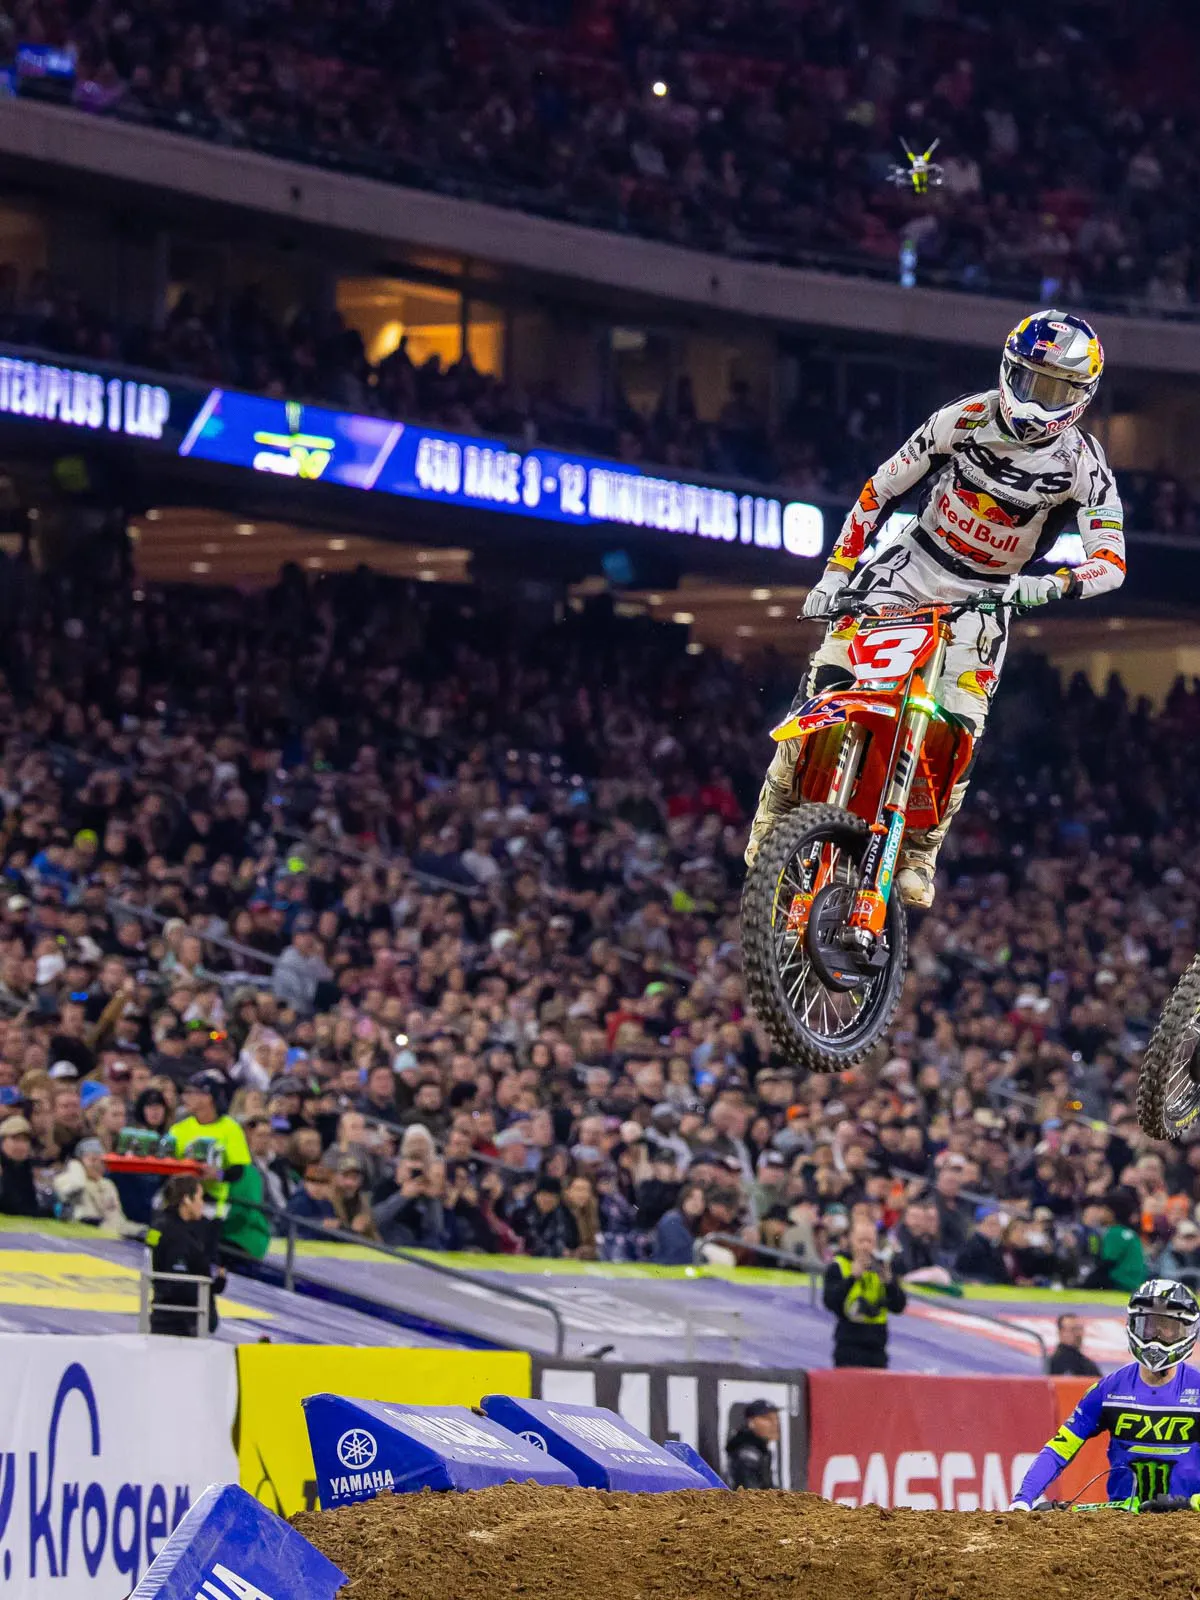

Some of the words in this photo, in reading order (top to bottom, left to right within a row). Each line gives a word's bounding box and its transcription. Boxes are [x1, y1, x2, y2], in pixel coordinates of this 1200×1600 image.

[107, 379, 122, 432] 1
[124, 381, 170, 440] LAP
[559, 463, 587, 514] 12
[754, 497, 782, 550] LA
[938, 493, 975, 535] Red
[973, 522, 1020, 553] Bull
[853, 627, 929, 681] 3
[884, 819, 905, 873] MOTOREX
[1114, 1413, 1196, 1441] FXR
[329, 1469, 395, 1494] YAMAHA
